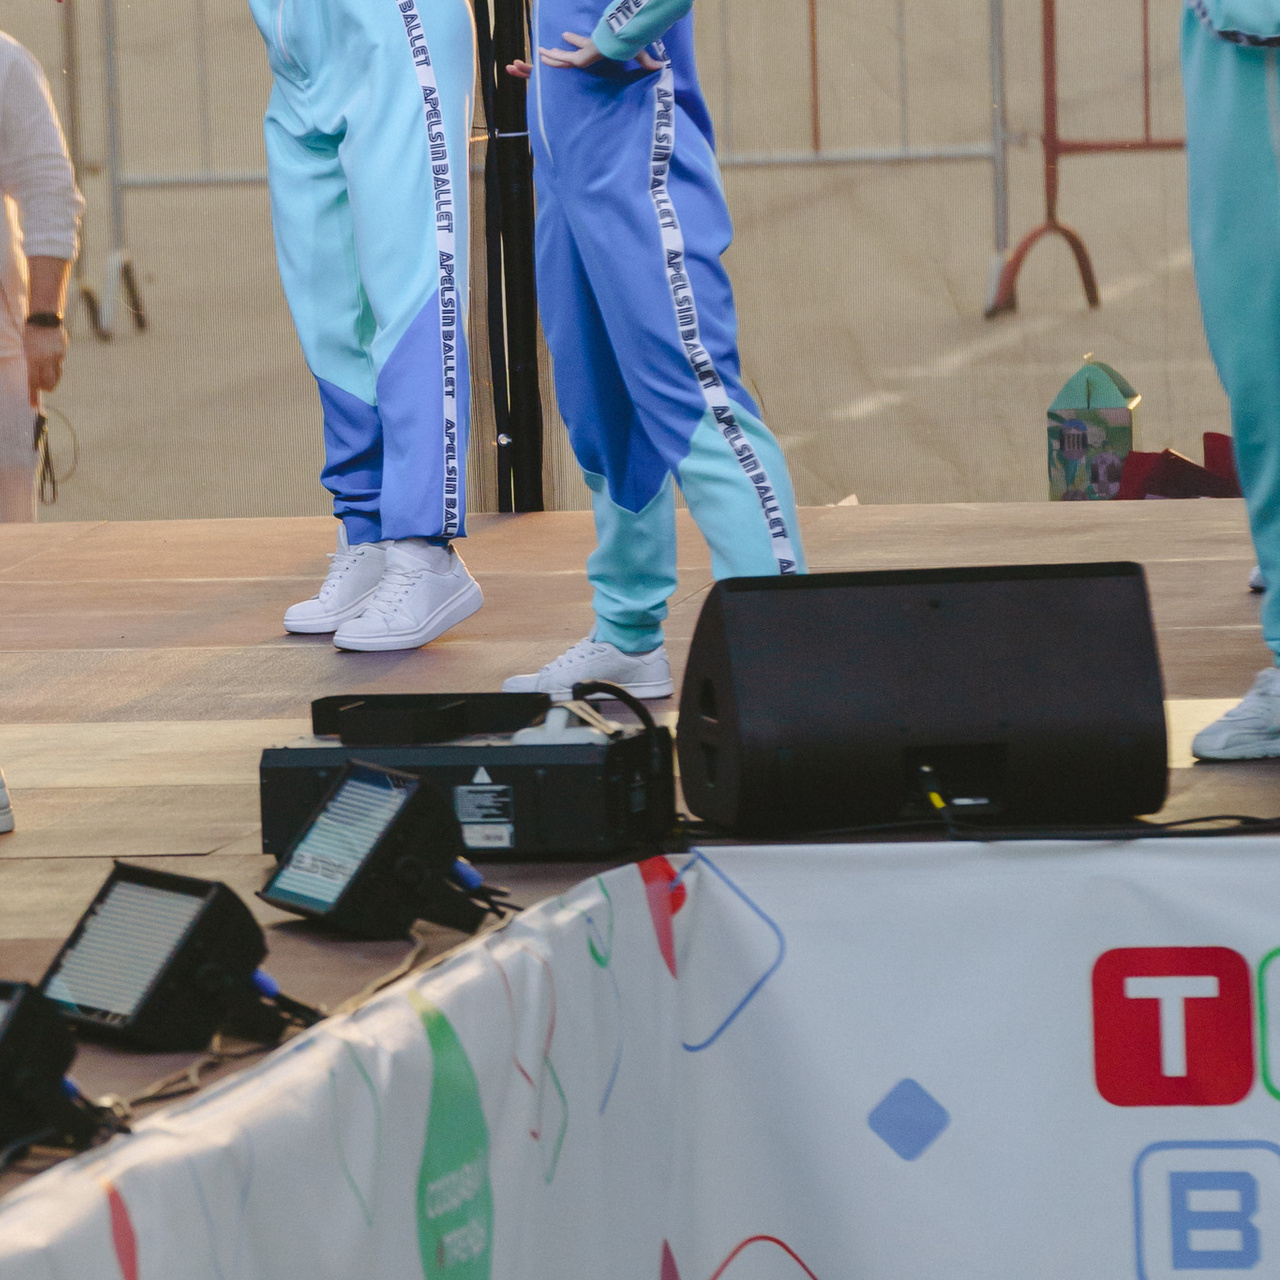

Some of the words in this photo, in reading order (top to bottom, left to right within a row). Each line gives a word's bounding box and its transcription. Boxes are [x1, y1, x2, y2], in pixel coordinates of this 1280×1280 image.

[398, 0, 431, 67] BALLET
[421, 86, 447, 162] APELSIN
[653, 87, 673, 162] APELSIN
[432, 164, 454, 233] BALLET
[650, 164, 678, 230] BALLET
[438, 250, 456, 326] APELSIN
[665, 248, 696, 328] APELSIN
[442, 330, 456, 399] BALLET
[678, 326, 720, 390] BALLET
[445, 419, 458, 495] APELSIN
[711, 405, 761, 477] APELSIN
[750, 470, 789, 540] BALLET
